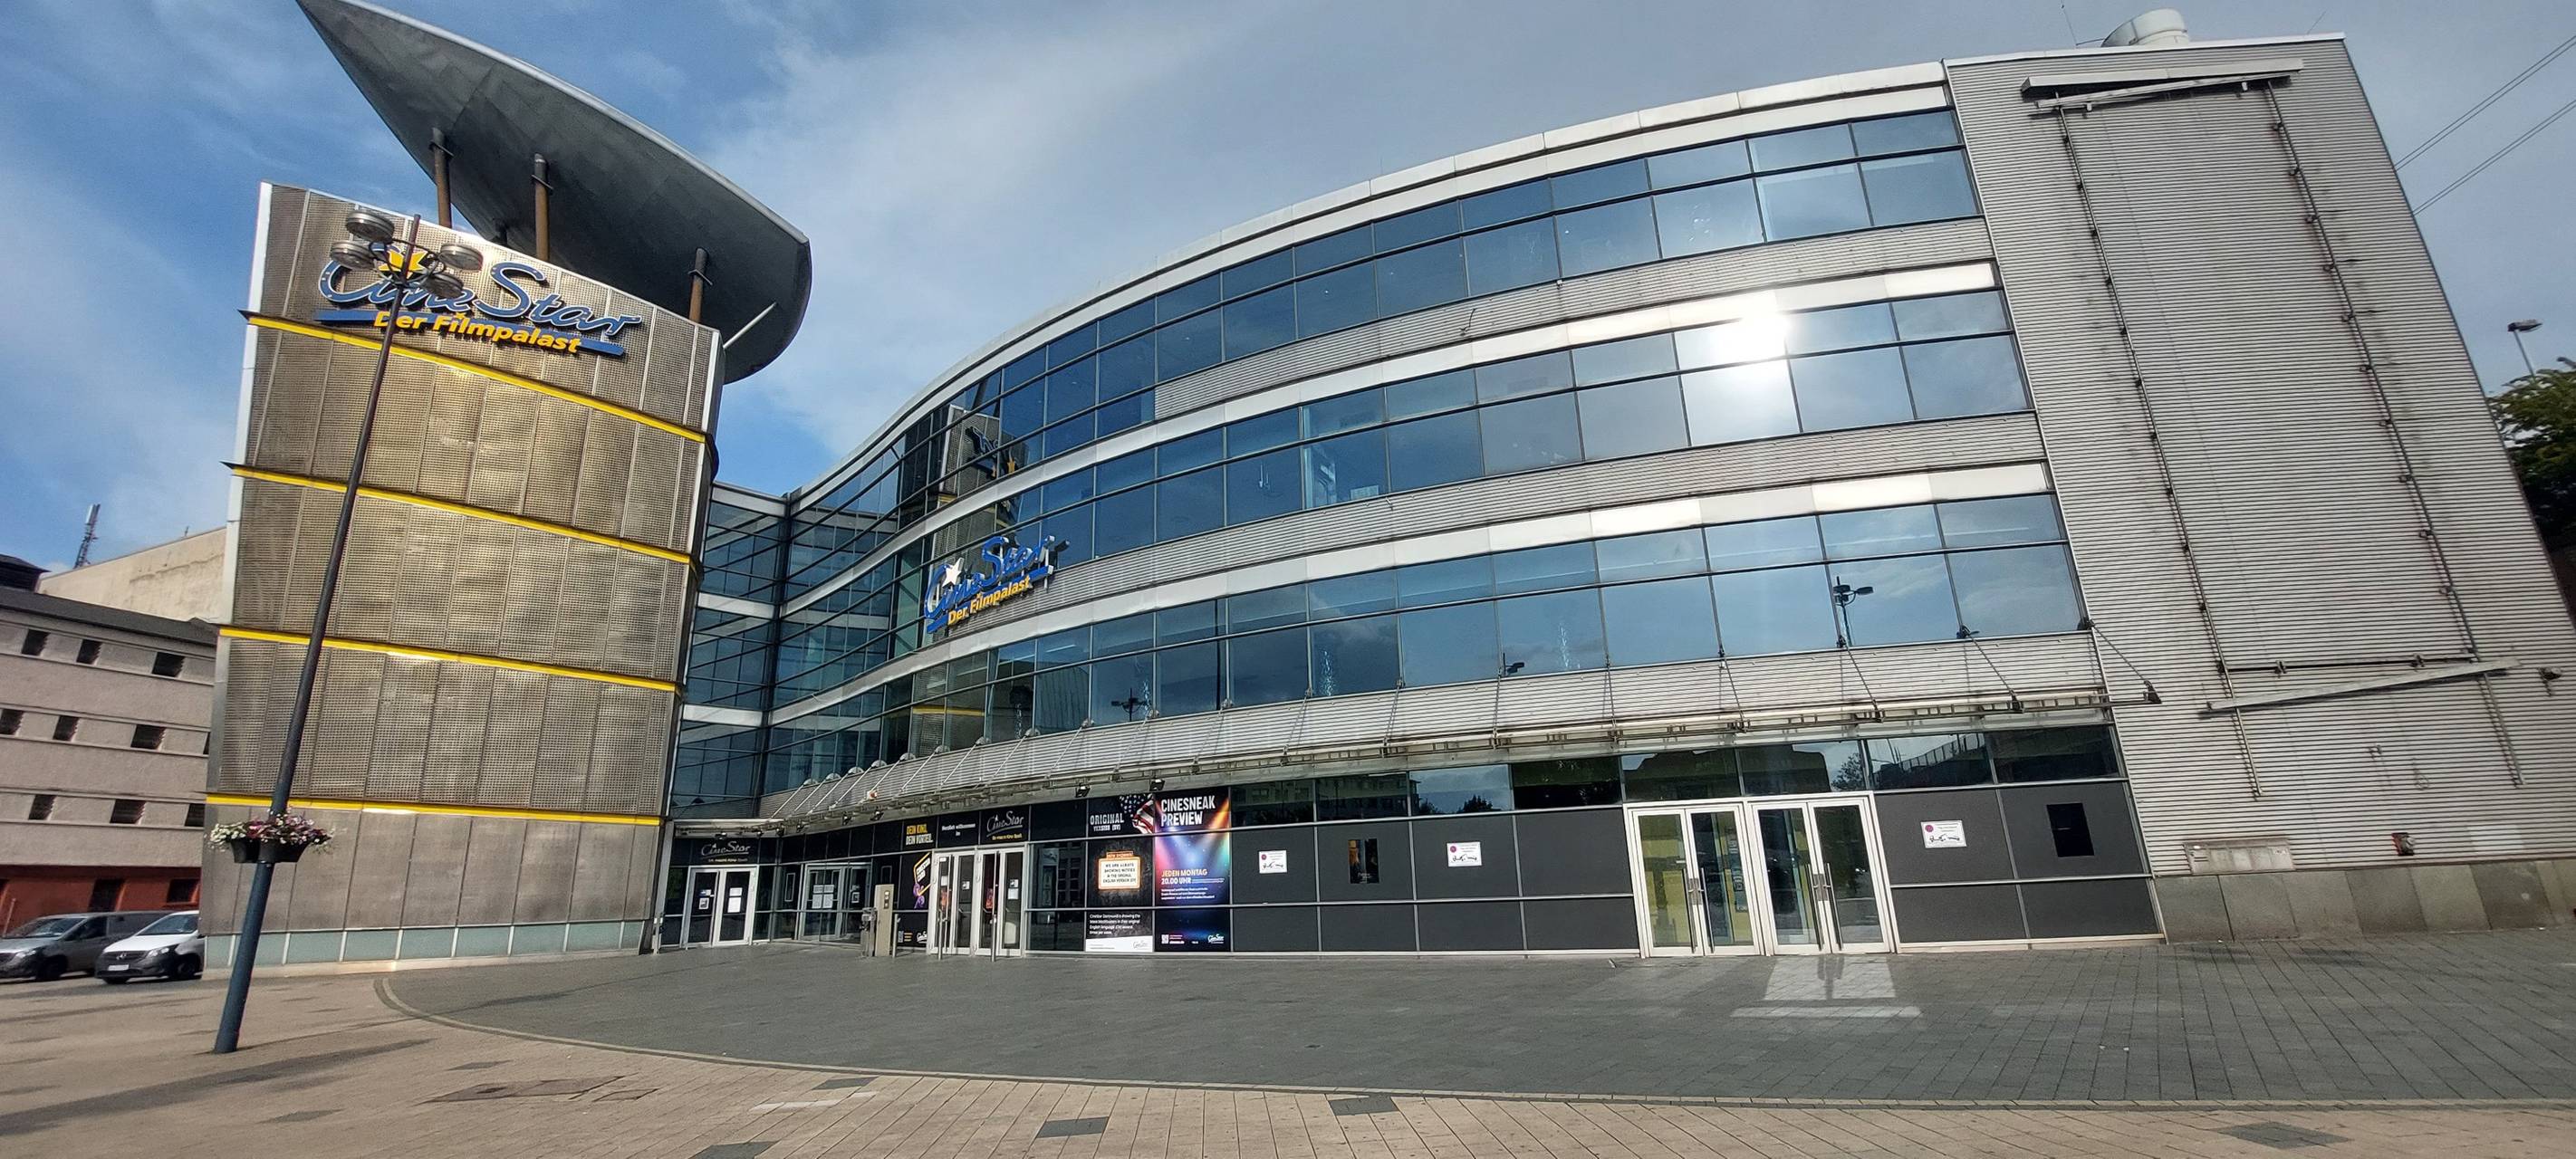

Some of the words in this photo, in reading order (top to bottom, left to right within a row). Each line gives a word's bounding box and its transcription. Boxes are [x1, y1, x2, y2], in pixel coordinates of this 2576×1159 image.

[374, 311, 428, 329] Der
[432, 312, 582, 354] Filmpalast
[947, 608, 968, 625] Der
[970, 575, 1031, 614] Filmpalast
[1160, 795, 1216, 812] CINESNEAK
[1090, 813, 1124, 825] ORIGINAL
[1160, 811, 1203, 827] PREVIEW
